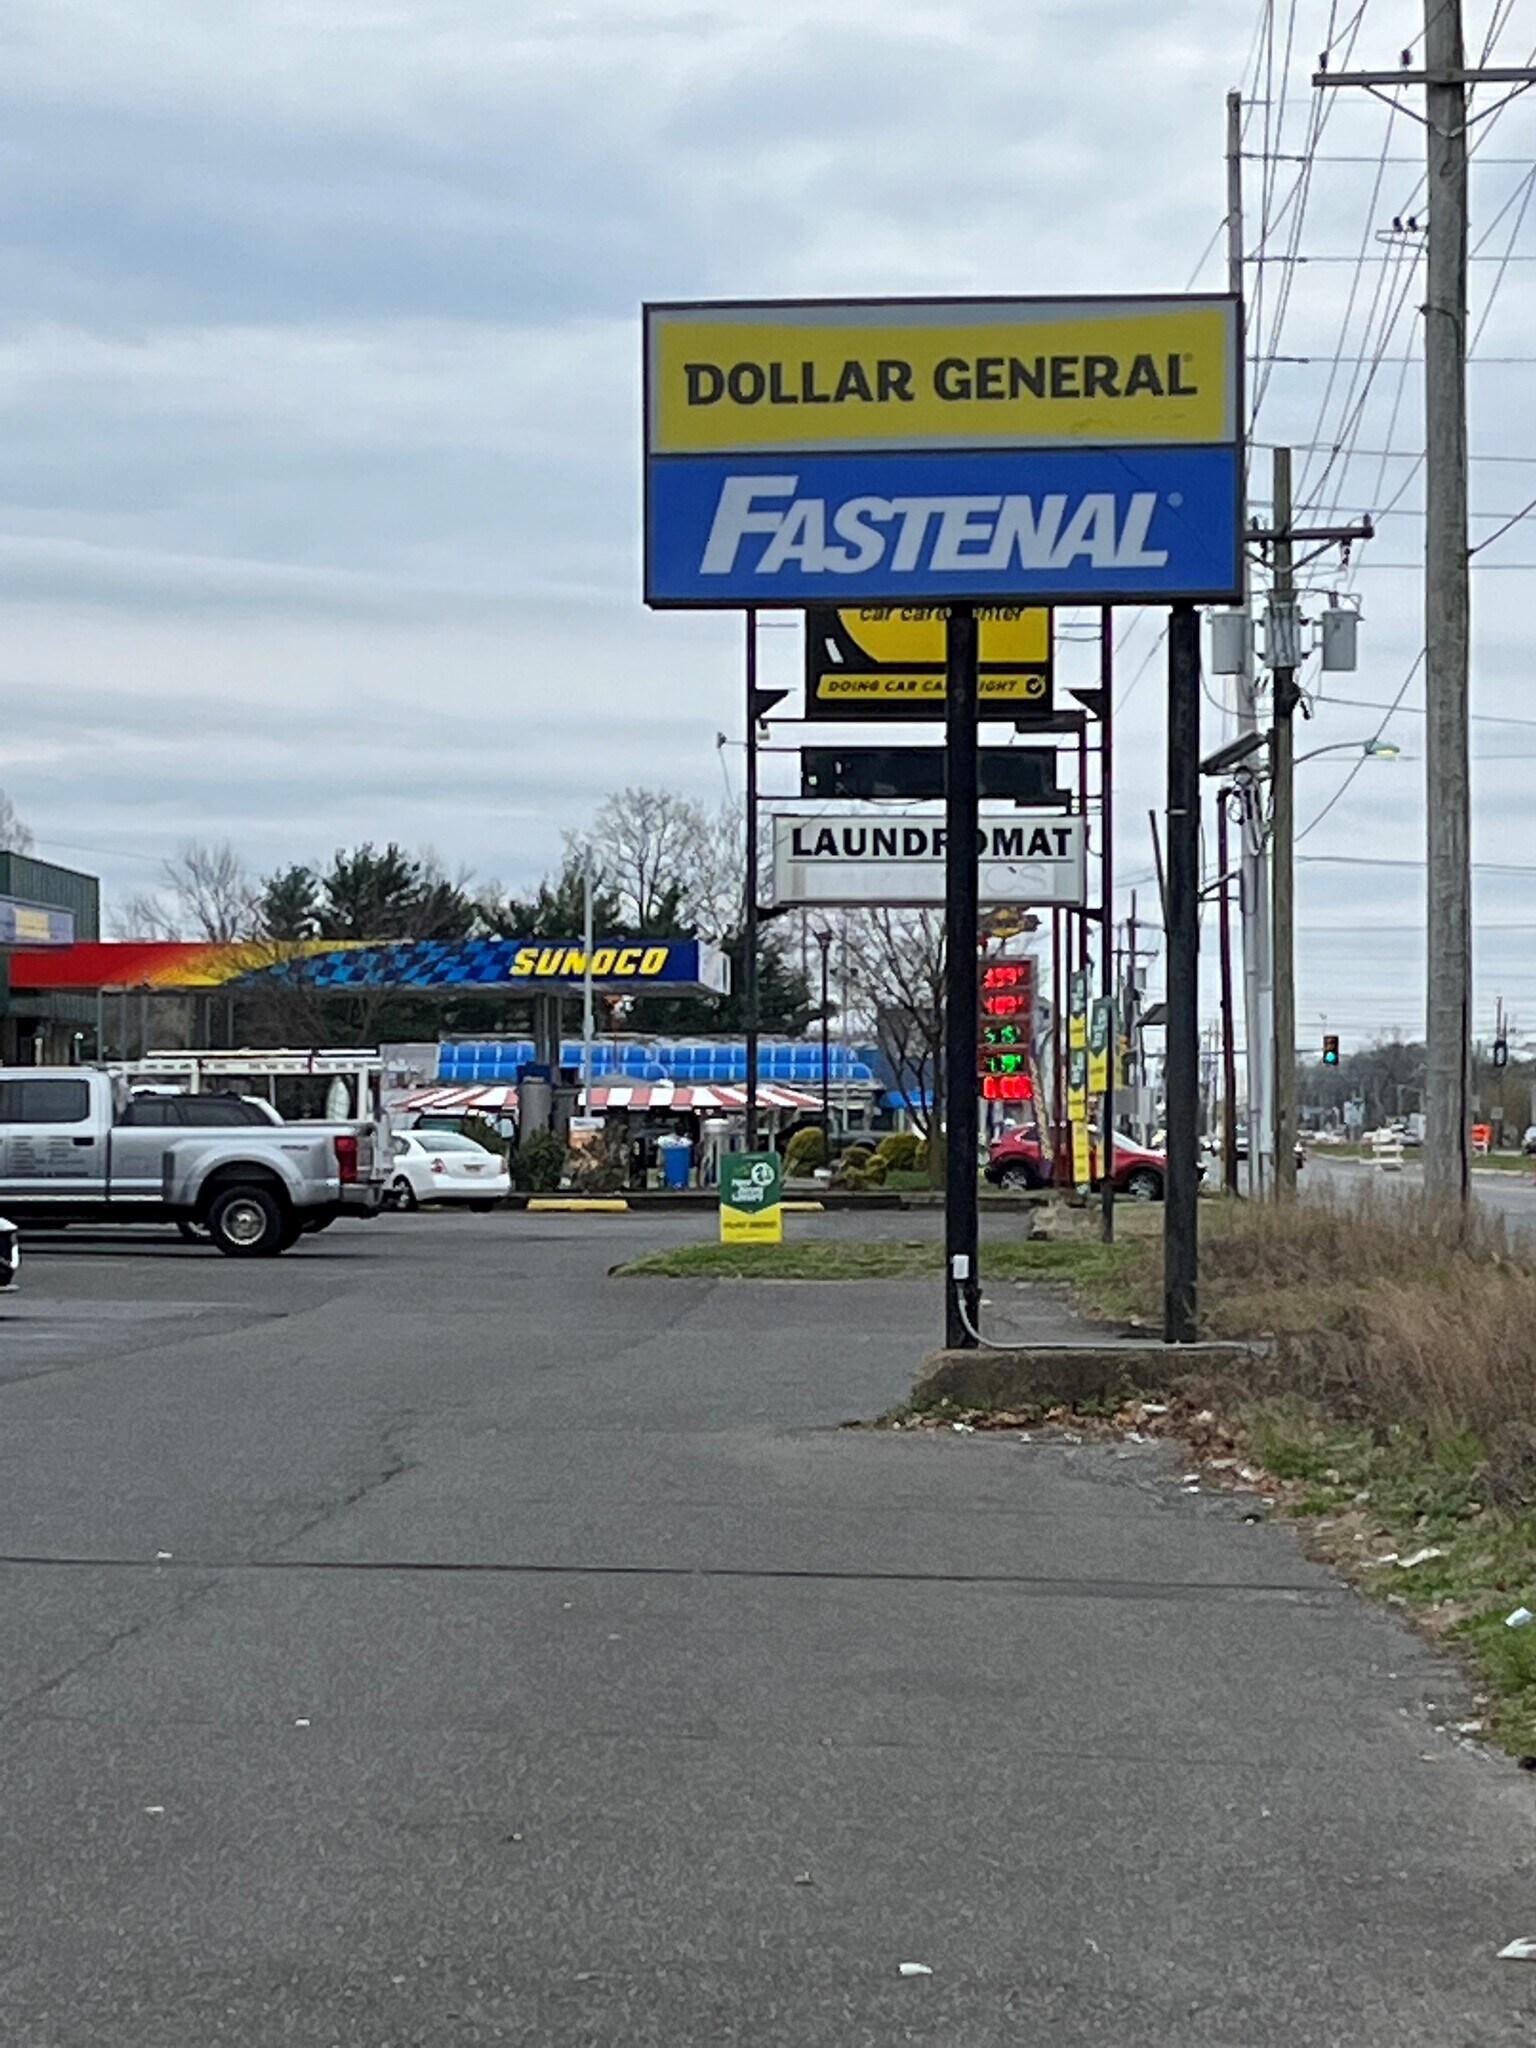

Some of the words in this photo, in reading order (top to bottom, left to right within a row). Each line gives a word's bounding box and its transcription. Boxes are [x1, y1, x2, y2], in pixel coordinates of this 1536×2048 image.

[683, 359, 915, 406] DOLLAR
[933, 353, 1198, 401] GENERAL
[700, 475, 1169, 575] FASTENAL
[828, 680, 879, 692] DOING
[884, 680, 917, 692] CAR
[922, 680, 946, 692] CA
[979, 680, 1017, 692] IGHT
[509, 947, 669, 976] SUNOCO
